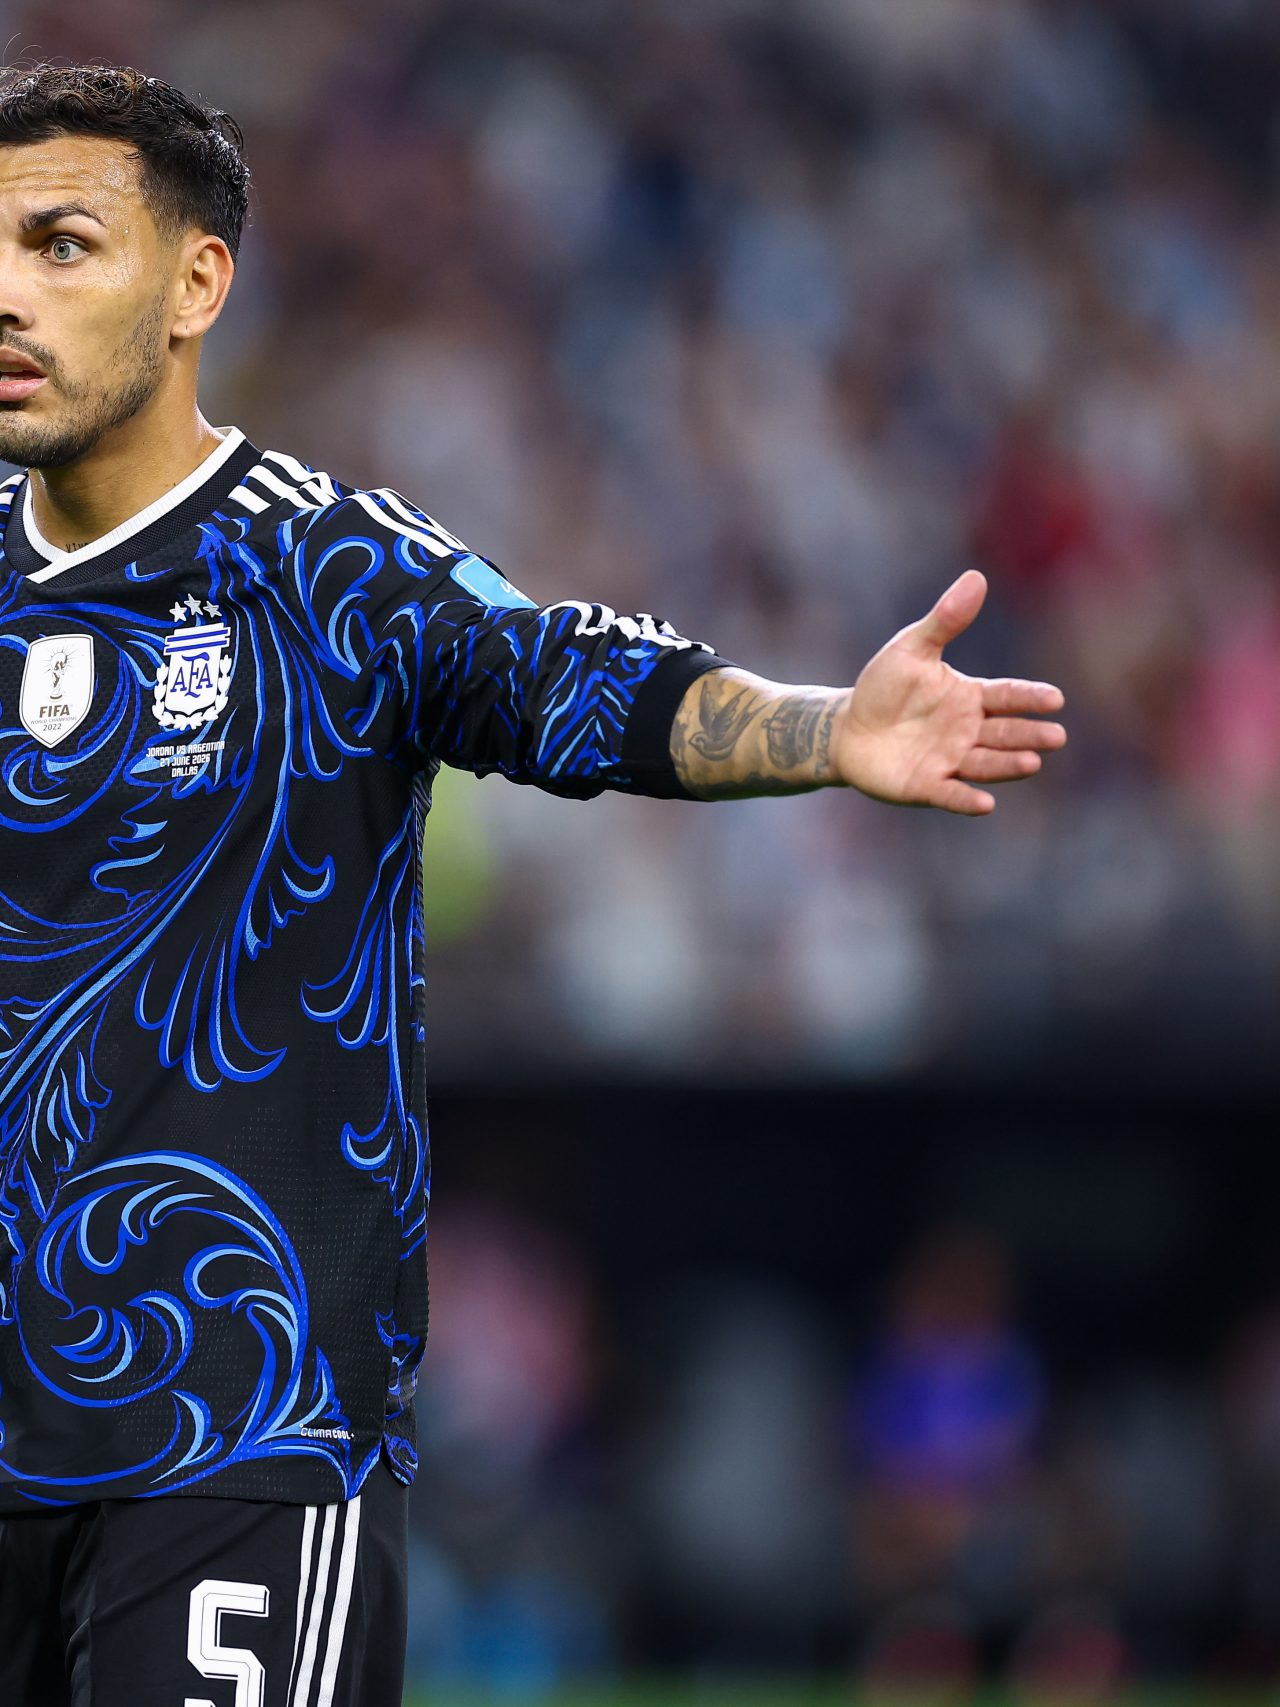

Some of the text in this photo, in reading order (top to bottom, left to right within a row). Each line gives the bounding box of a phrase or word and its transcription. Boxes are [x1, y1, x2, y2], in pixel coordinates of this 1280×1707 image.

[170, 652, 213, 698] AFA
[39, 704, 70, 718] FIFA
[43, 723, 62, 731] 2022
[146, 741, 225, 757] JORDAN VS ARGENTINA
[172, 756, 190, 766] JUNE
[192, 754, 210, 764] 2026
[171, 766, 198, 777] DALLAS
[184, 1579, 270, 1707] 5
